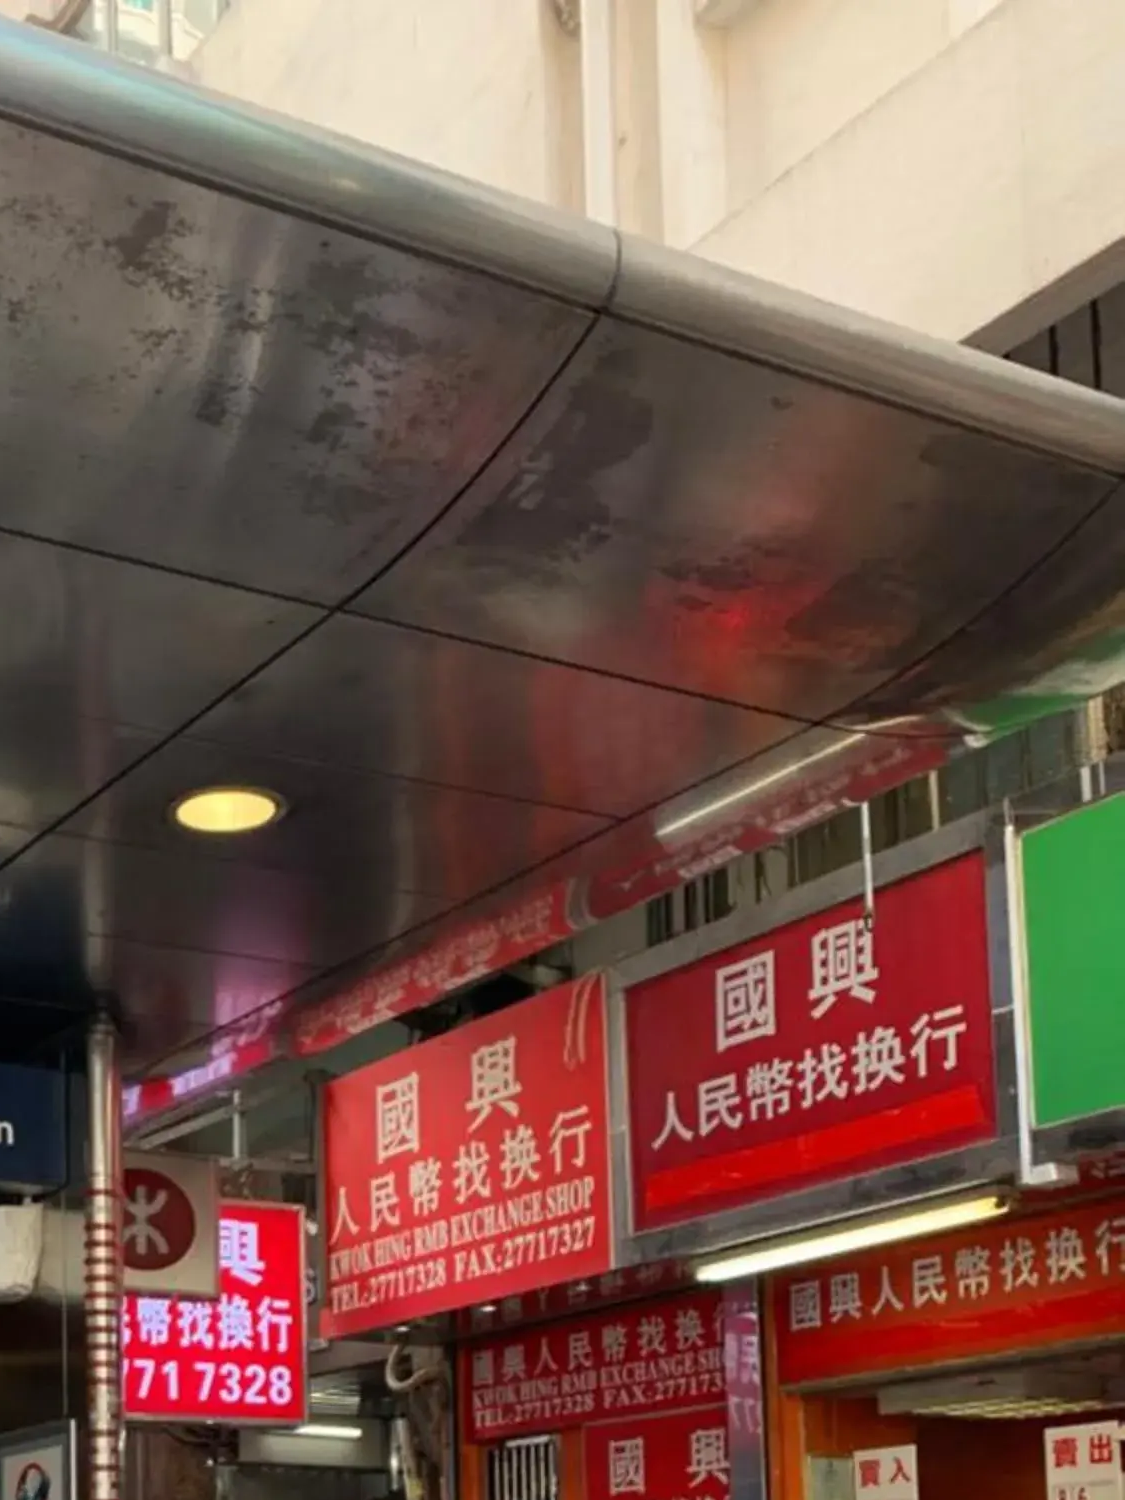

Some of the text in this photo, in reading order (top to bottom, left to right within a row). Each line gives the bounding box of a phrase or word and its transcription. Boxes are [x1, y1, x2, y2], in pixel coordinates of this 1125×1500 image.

[715, 917, 879, 1053] 國興
[376, 1035, 522, 1165] 國興
[651, 1005, 968, 1151] 人民幣找換行
[329, 1105, 592, 1245] 人民幣找換行
[450, 1190, 543, 1247] EXCHANGE
[546, 1175, 595, 1220] SHOP
[193, 1361, 293, 1406] 7328
